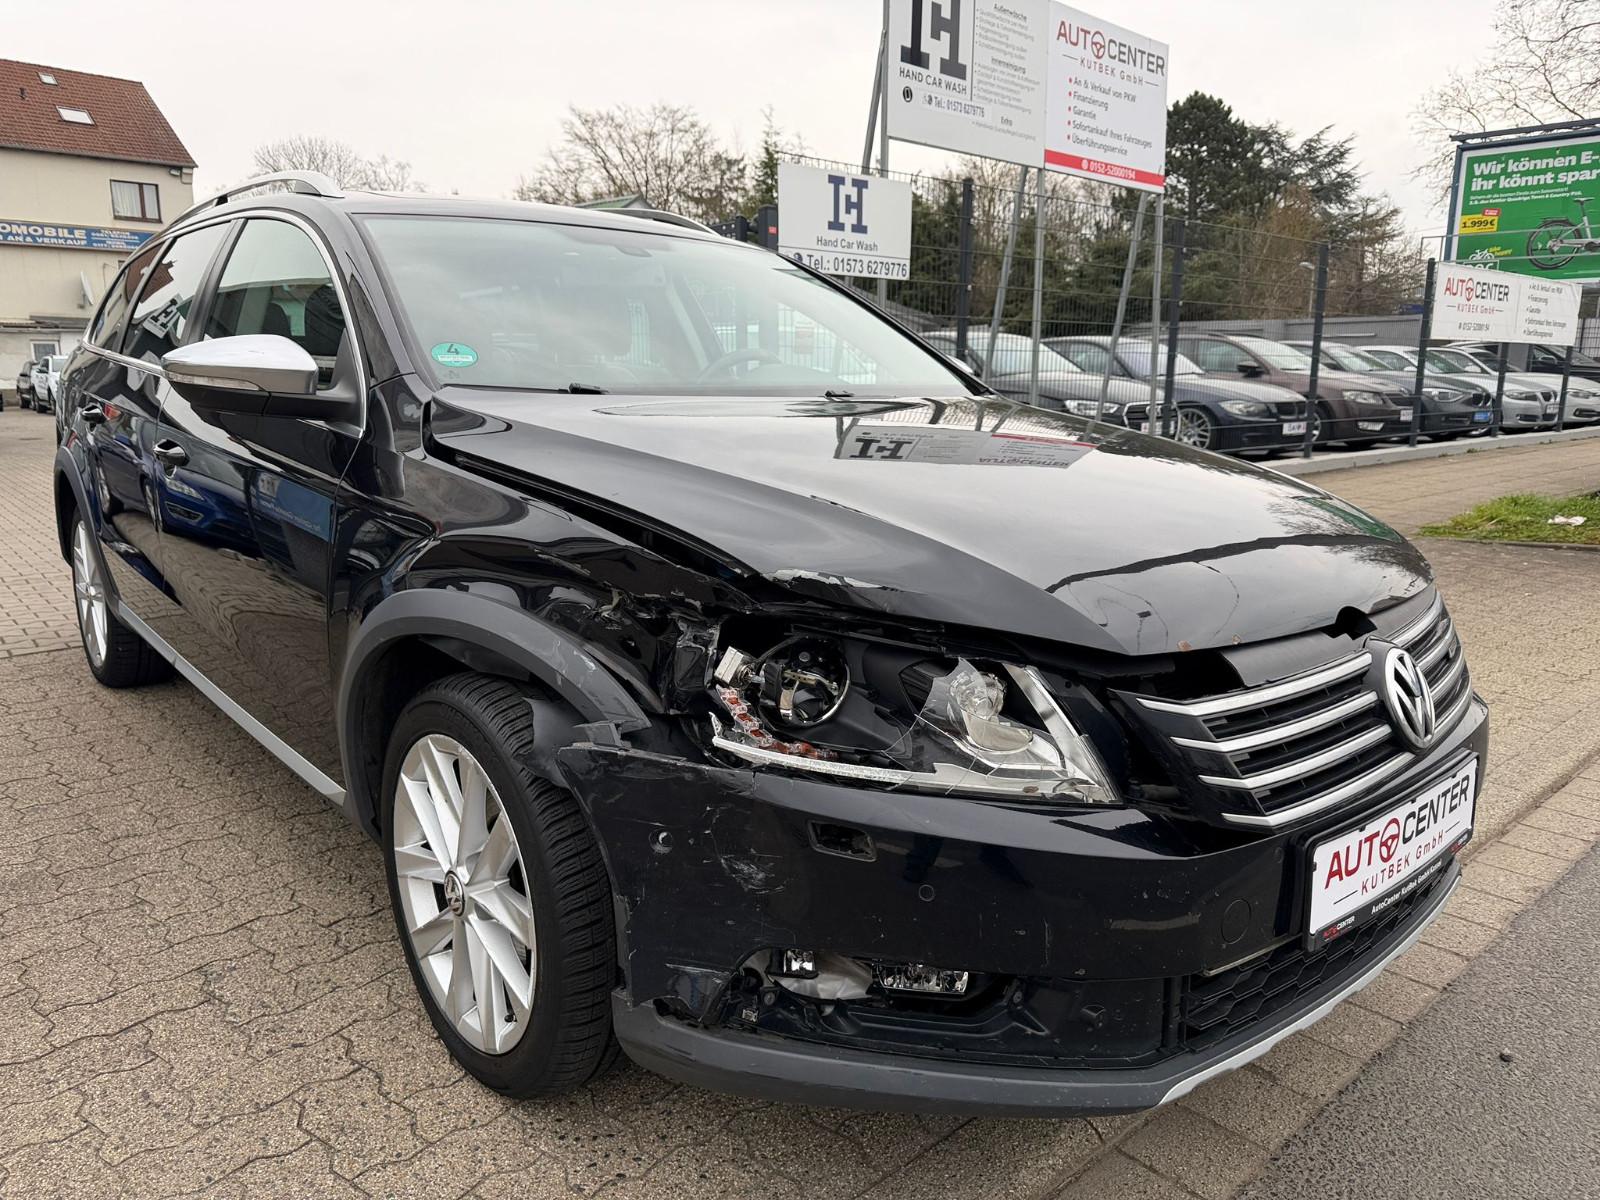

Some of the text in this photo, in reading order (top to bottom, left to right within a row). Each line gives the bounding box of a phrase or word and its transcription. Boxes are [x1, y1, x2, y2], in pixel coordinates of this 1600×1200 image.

[899, 67, 923, 83] HAND
[925, 74, 942, 89] CAR
[944, 79, 967, 95] WASH
[1080, 57, 1144, 86] KUTBEK GmbH
[1073, 77, 1082, 87] An
[1090, 80, 1111, 96] Verkauf
[1112, 89, 1122, 99] von
[1124, 91, 1136, 102] PKW
[1073, 91, 1108, 111] Finanzierung
[1072, 105, 1096, 120] Garantie
[1072, 120, 1109, 137] Sofortankauf
[1473, 161, 1505, 176] Wir
[1507, 155, 1577, 173] können
[1471, 178, 1497, 191] ihr
[1499, 172, 1555, 189] könnt
[35, 237, 88, 246] VERKAUF
[816, 235, 879, 252] Hand Car Wash
[833, 257, 864, 274] 01573
[867, 260, 908, 278] 6279776
[447, 344, 460, 355] 4
[1361, 852, 1411, 896] KUTBEK
[1415, 829, 1444, 860] GmbH
